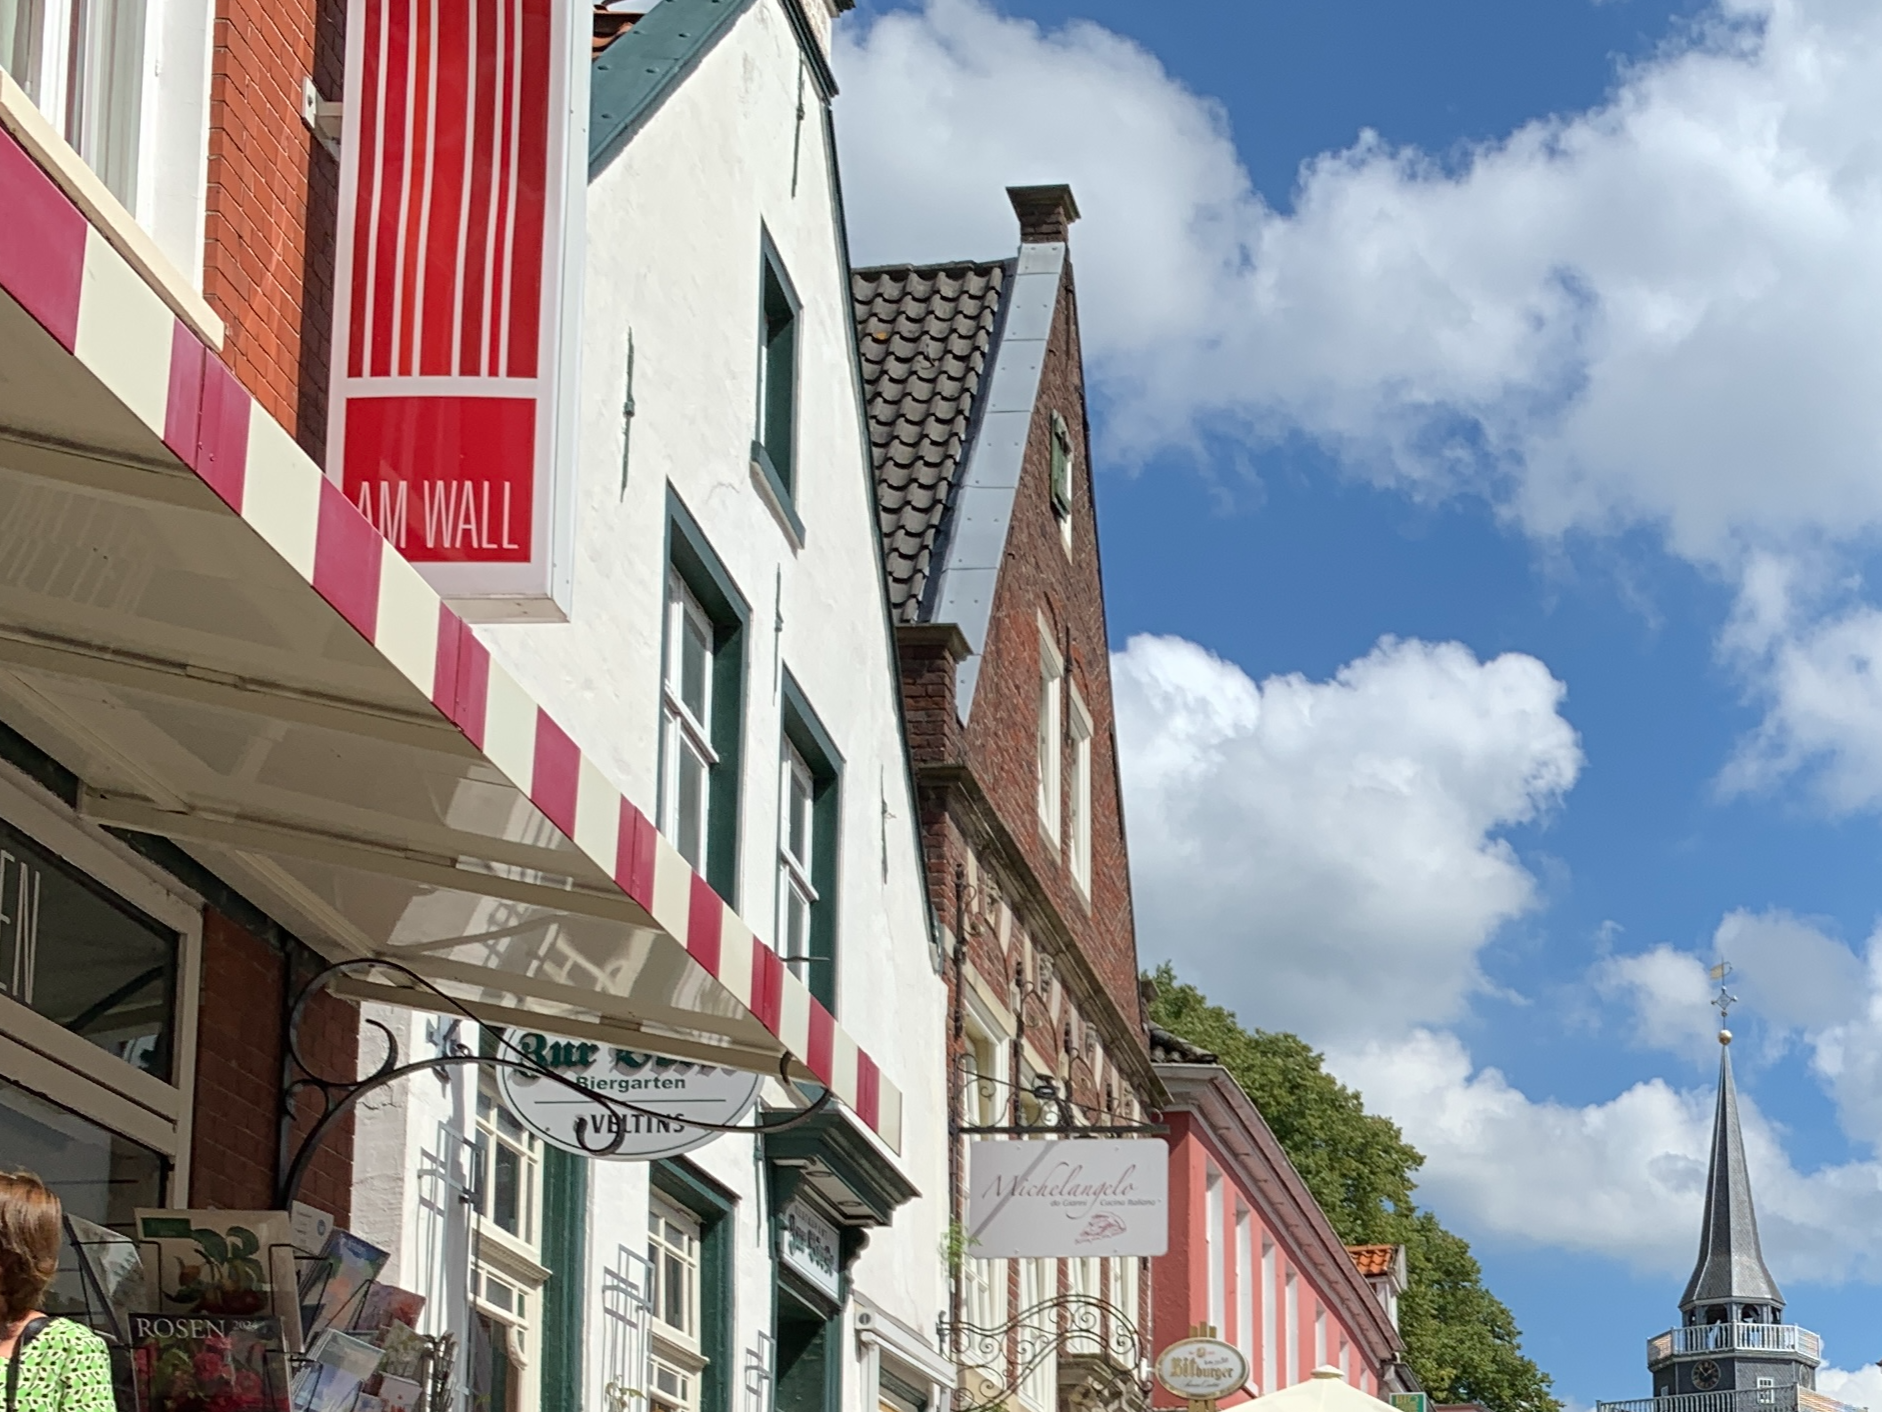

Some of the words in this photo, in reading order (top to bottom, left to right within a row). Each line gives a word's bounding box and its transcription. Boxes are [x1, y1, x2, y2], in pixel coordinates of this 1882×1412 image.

[357, 480, 407, 549] AM
[424, 480, 519, 549] WALL
[577, 1076, 686, 1093] Biergarten
[591, 1113, 686, 1134] VELTINS
[982, 1161, 1138, 1219] Michelangelo
[136, 1317, 226, 1339] ROSEN
[1170, 1356, 1234, 1381] Bitburger
